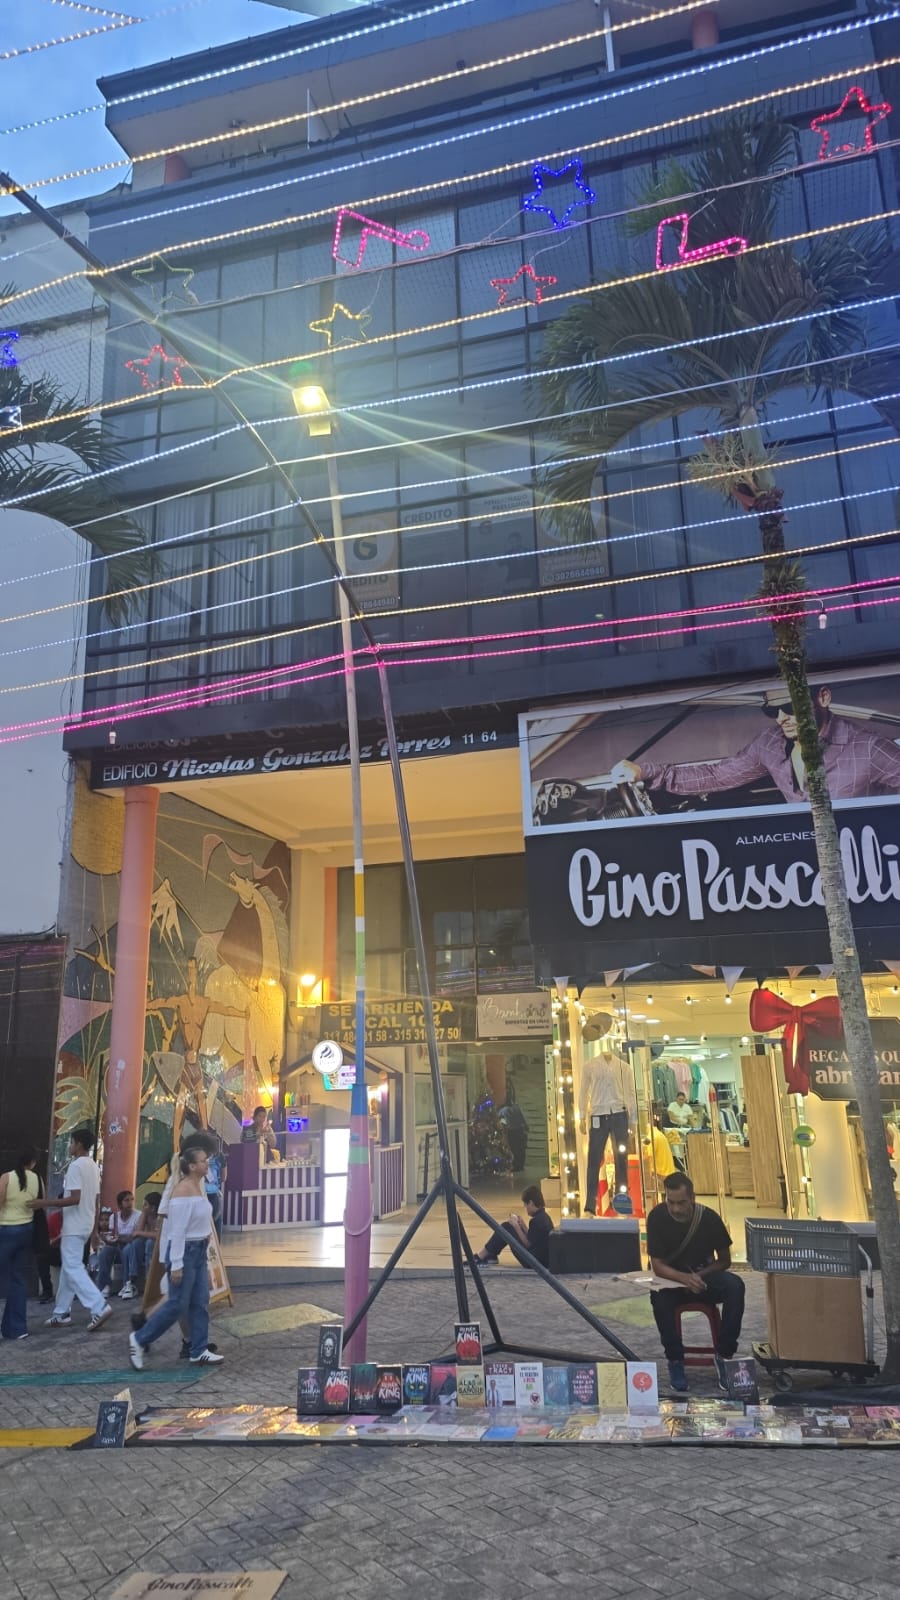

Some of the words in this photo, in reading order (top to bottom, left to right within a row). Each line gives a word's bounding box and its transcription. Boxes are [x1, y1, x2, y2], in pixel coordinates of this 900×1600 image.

[103, 762, 158, 782] EDIFICIO
[162, 755, 255, 778] Nicolas
[261, 743, 373, 773] Gonzalz
[462, 733, 474, 745] 11
[481, 731, 498, 743] 64
[735, 830, 817, 846] ALMACENES
[329, 1005, 352, 1017] SE
[376, 1030, 387, 1041] 58
[394, 1029, 412, 1041] 315
[414, 1028, 428, 1040] 31
[447, 1027, 459, 1039] 50
[809, 1049, 880, 1063] REGAS
[457, 1332, 479, 1343] KING
[327, 1375, 348, 1388] KING
[406, 1372, 428, 1384] KING
[378, 1386, 401, 1399] KING
